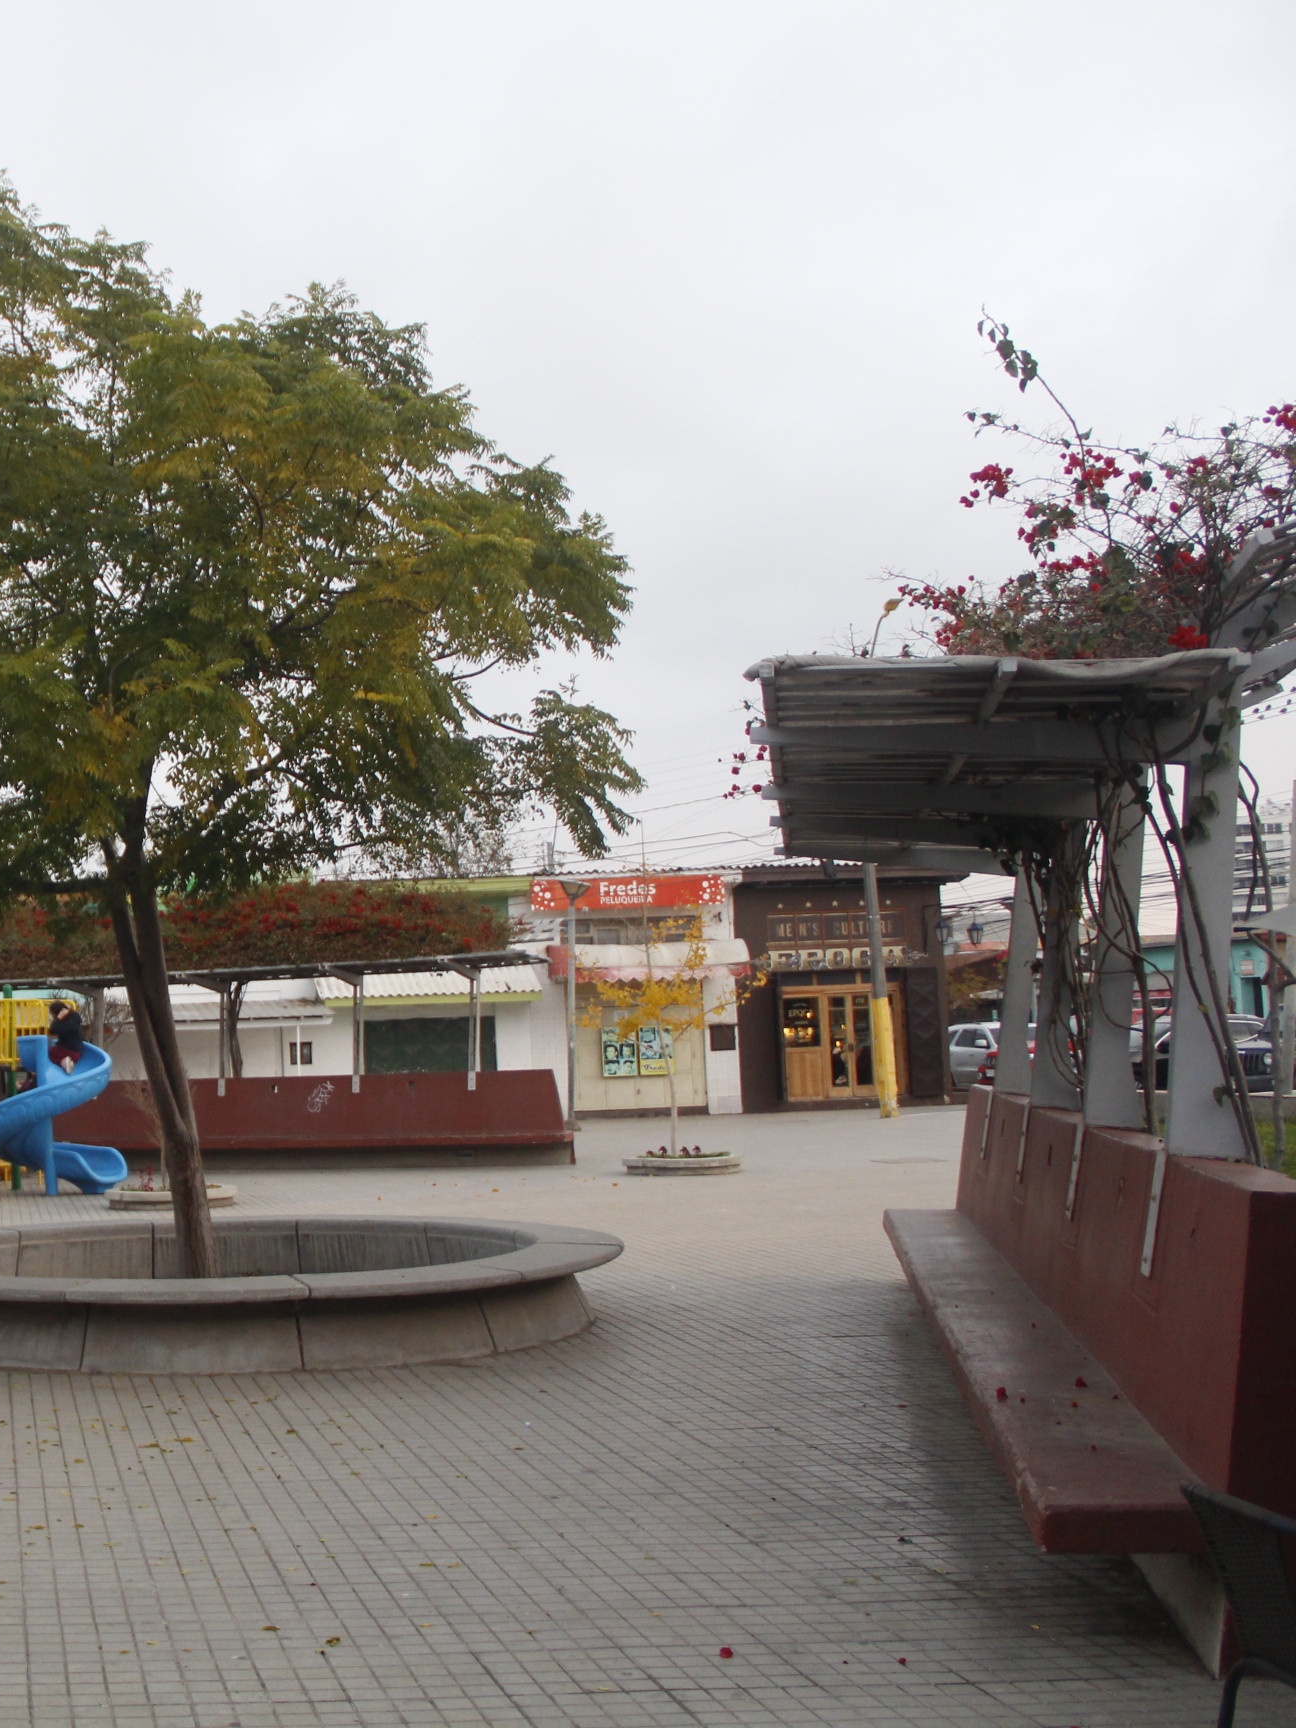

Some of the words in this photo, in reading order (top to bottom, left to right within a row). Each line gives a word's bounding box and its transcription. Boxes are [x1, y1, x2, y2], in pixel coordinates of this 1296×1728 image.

[599, 880, 657, 896] Fredes
[600, 895, 653, 905] PELUQUERA
[776, 921, 820, 937] MEN'S
[833, 919, 894, 936] CULTRE
[768, 946, 907, 971] EPOCA
